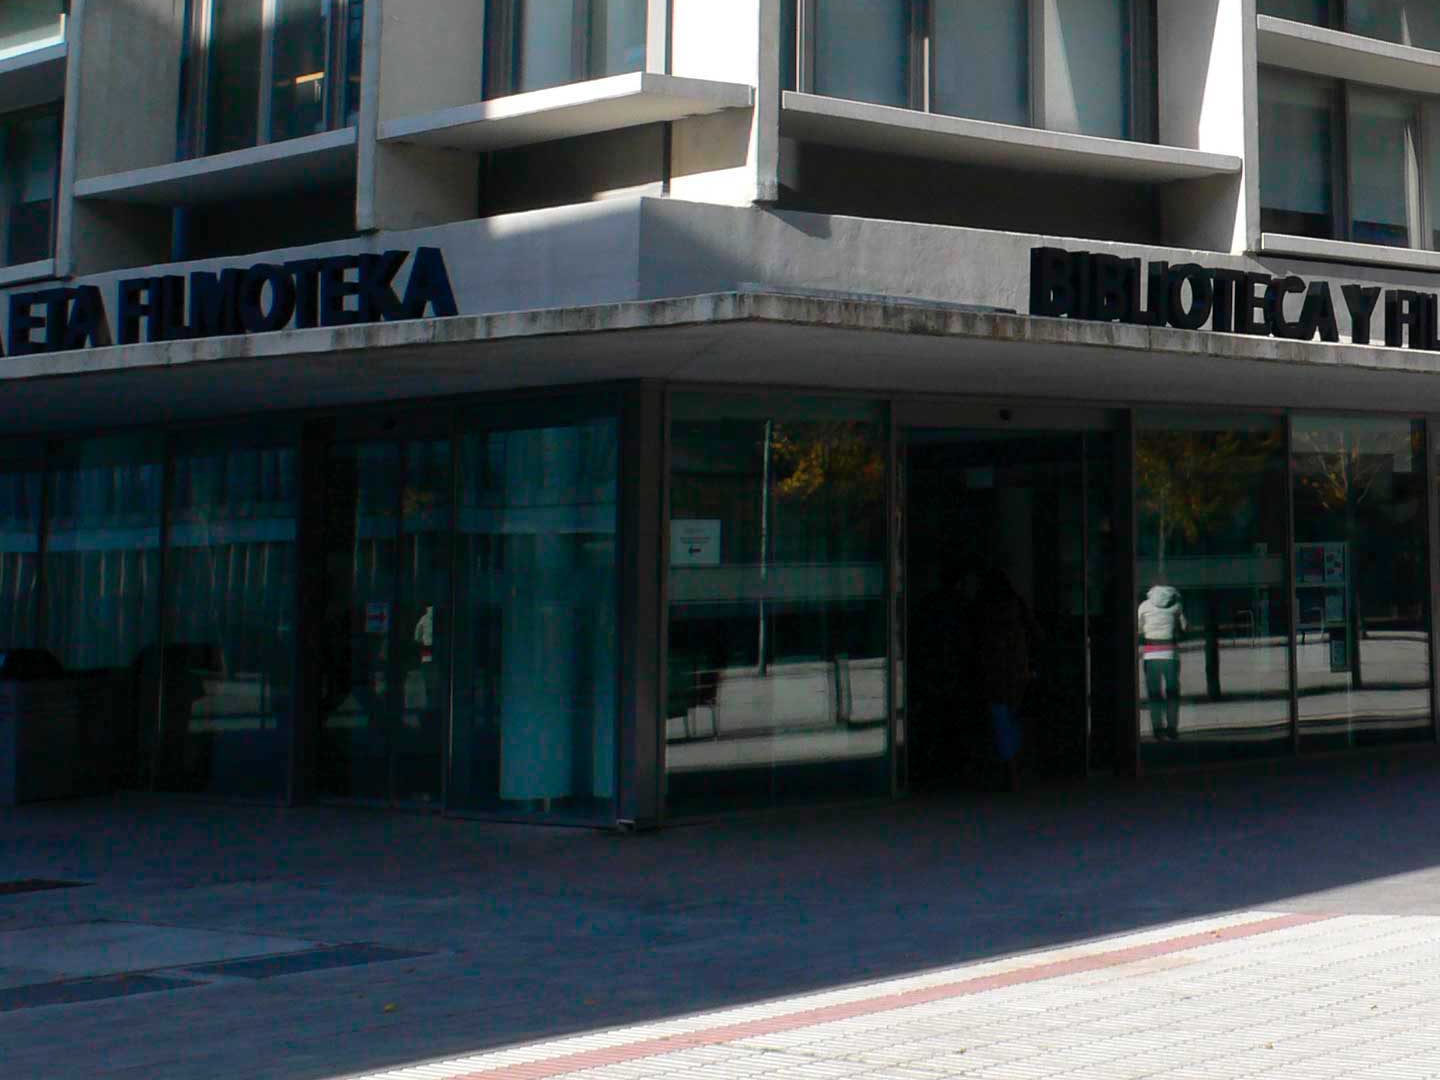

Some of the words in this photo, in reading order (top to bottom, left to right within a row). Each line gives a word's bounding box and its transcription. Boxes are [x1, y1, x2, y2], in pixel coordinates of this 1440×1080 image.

[8, 285, 113, 356] ETA
[117, 247, 458, 345] FILMOTEKA
[1030, 246, 1339, 343] BIBLIOTECA
[1341, 284, 1381, 345] Y
